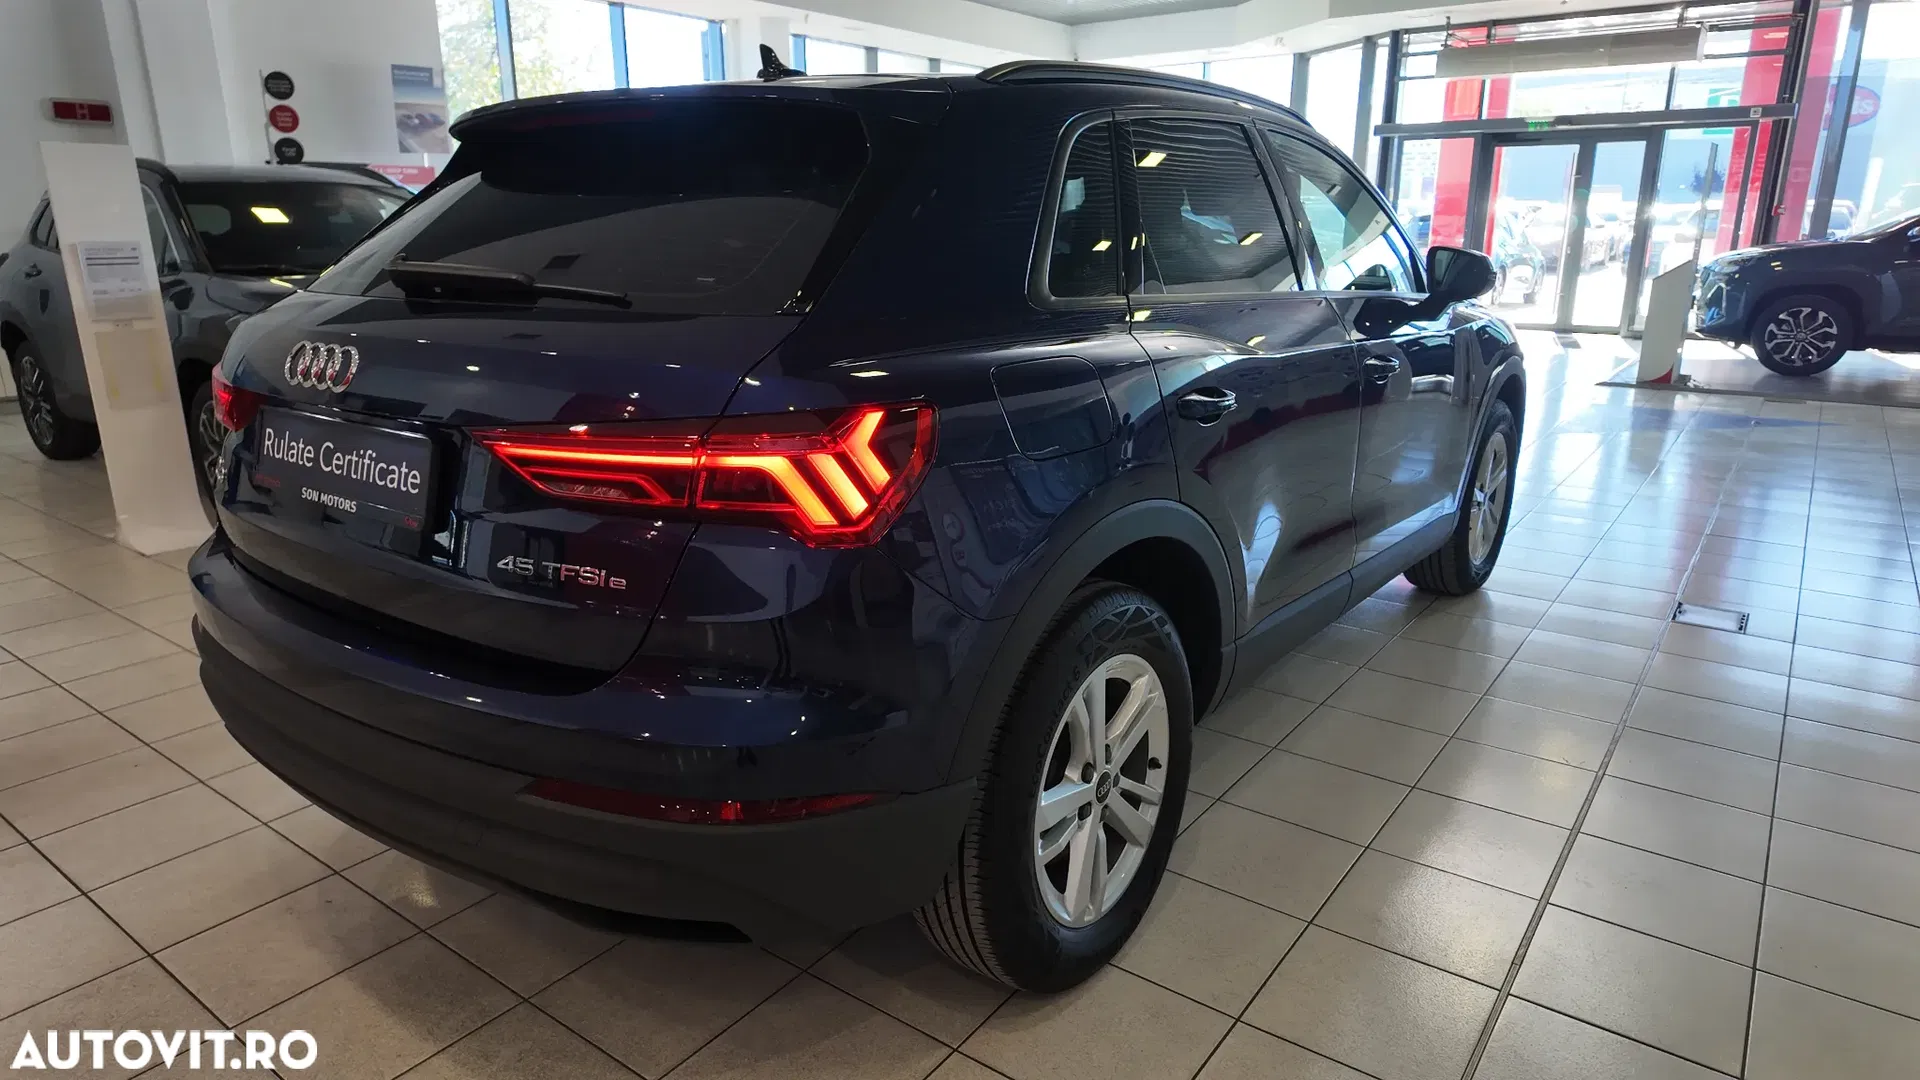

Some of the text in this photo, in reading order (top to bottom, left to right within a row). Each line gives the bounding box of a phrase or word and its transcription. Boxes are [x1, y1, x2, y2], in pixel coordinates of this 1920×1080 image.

[264, 427, 421, 495] Rulate Certificate
[301, 487, 357, 514] SON MOTORS
[497, 555, 534, 576] 45
